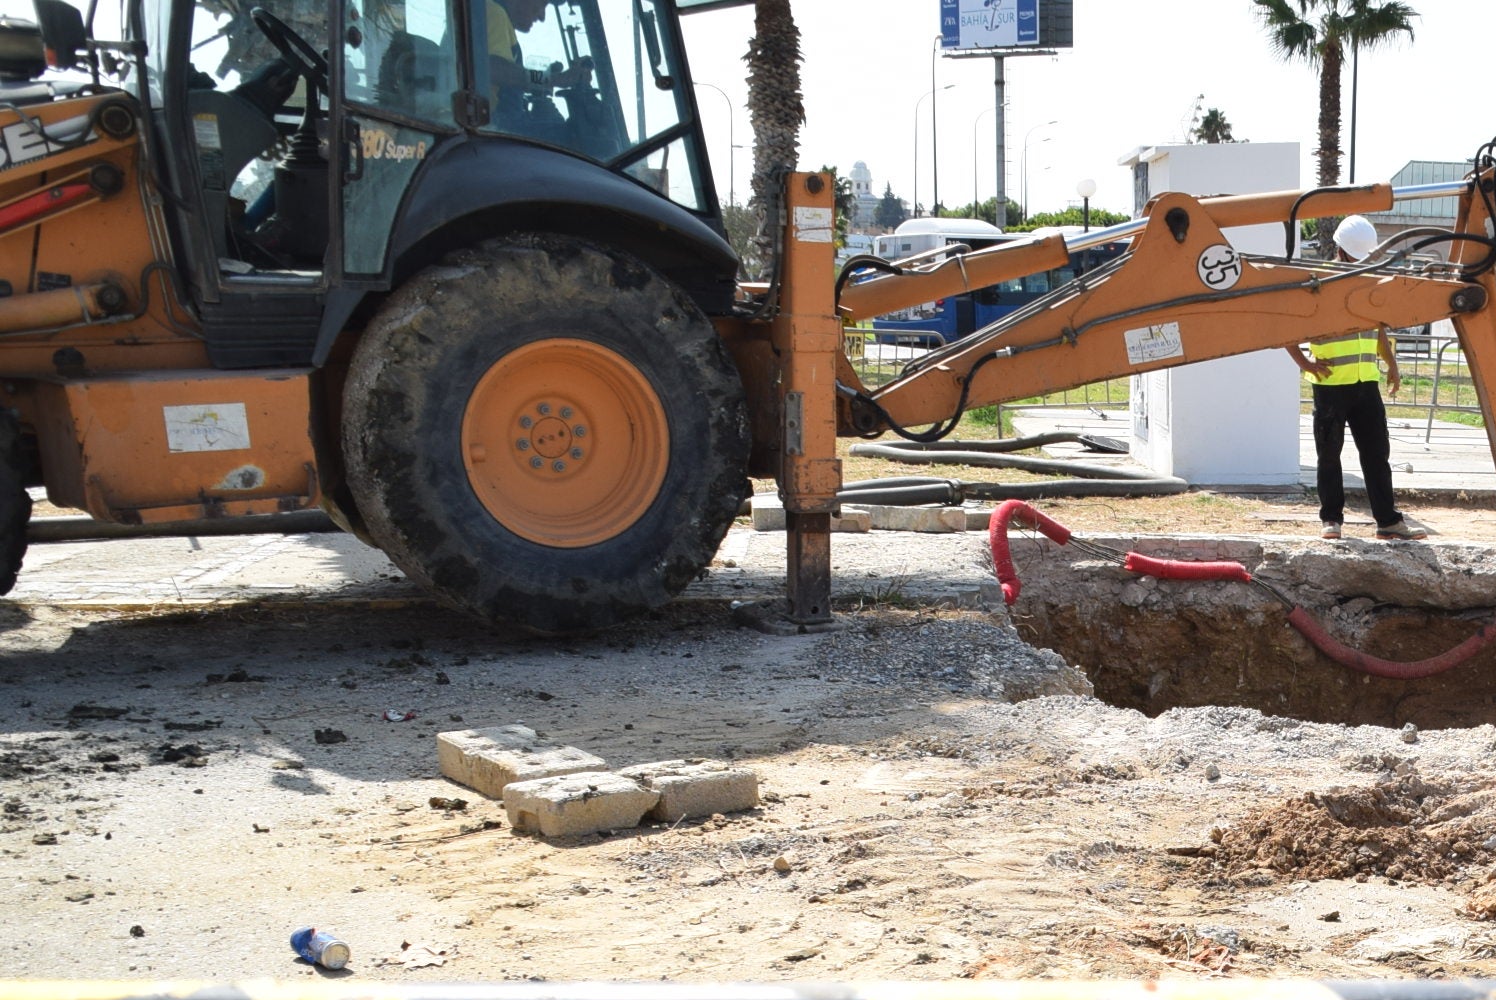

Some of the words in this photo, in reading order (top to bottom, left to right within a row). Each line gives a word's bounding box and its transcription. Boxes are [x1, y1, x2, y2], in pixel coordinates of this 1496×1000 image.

[961, 13, 989, 27] BAHÍA
[997, 13, 1015, 24] SUR
[385, 140, 416, 163] Super
[416, 141, 426, 160] R
[1201, 250, 1238, 285] 35
[845, 336, 862, 356] MR
